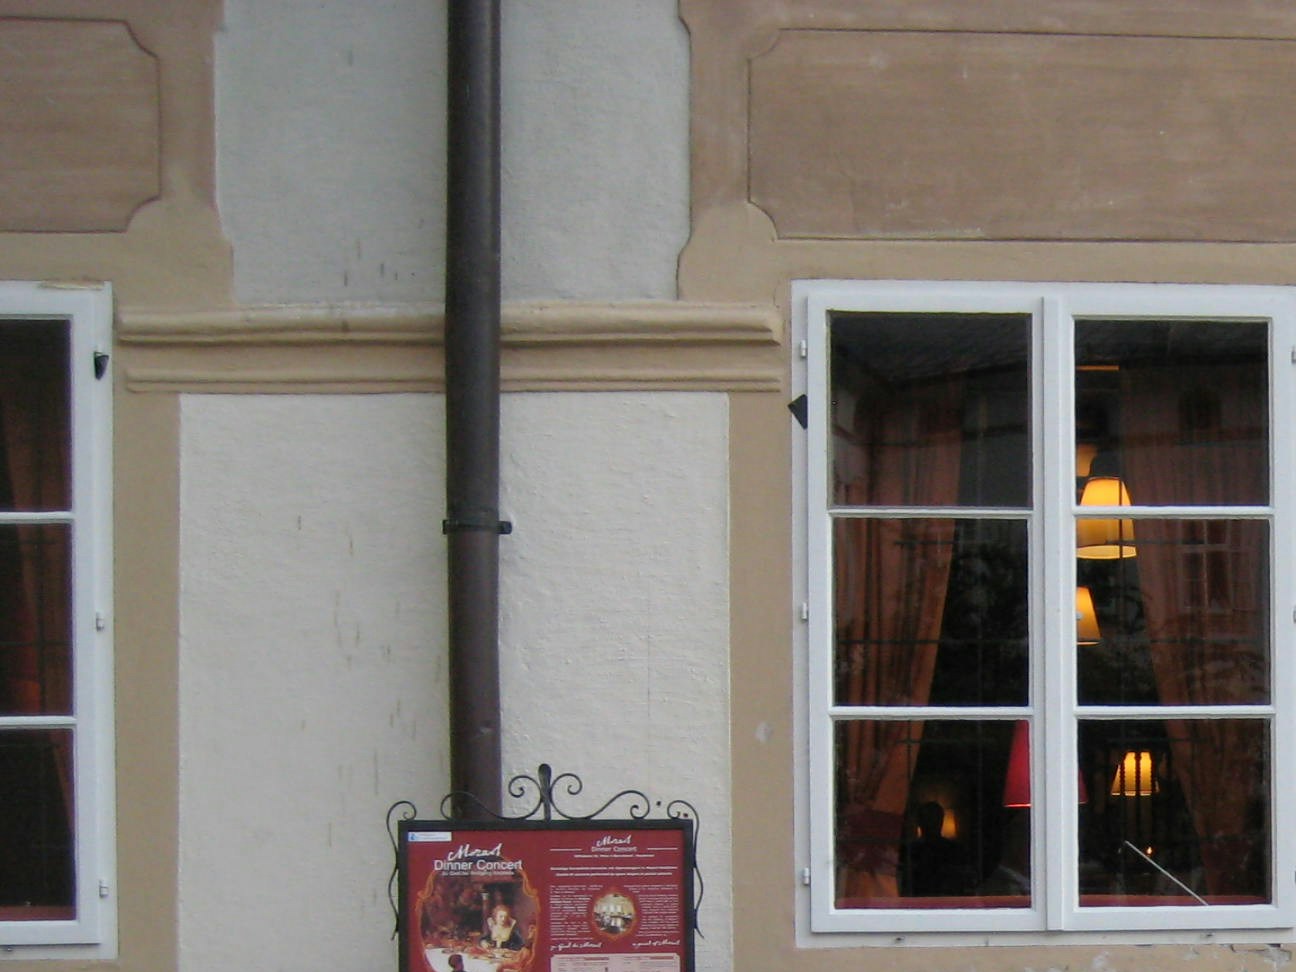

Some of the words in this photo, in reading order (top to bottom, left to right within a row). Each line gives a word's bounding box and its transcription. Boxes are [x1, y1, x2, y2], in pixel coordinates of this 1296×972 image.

[447, 843, 503, 861] Mozart
[434, 859, 473, 871] Dinner
[476, 859, 523, 871] Concert
